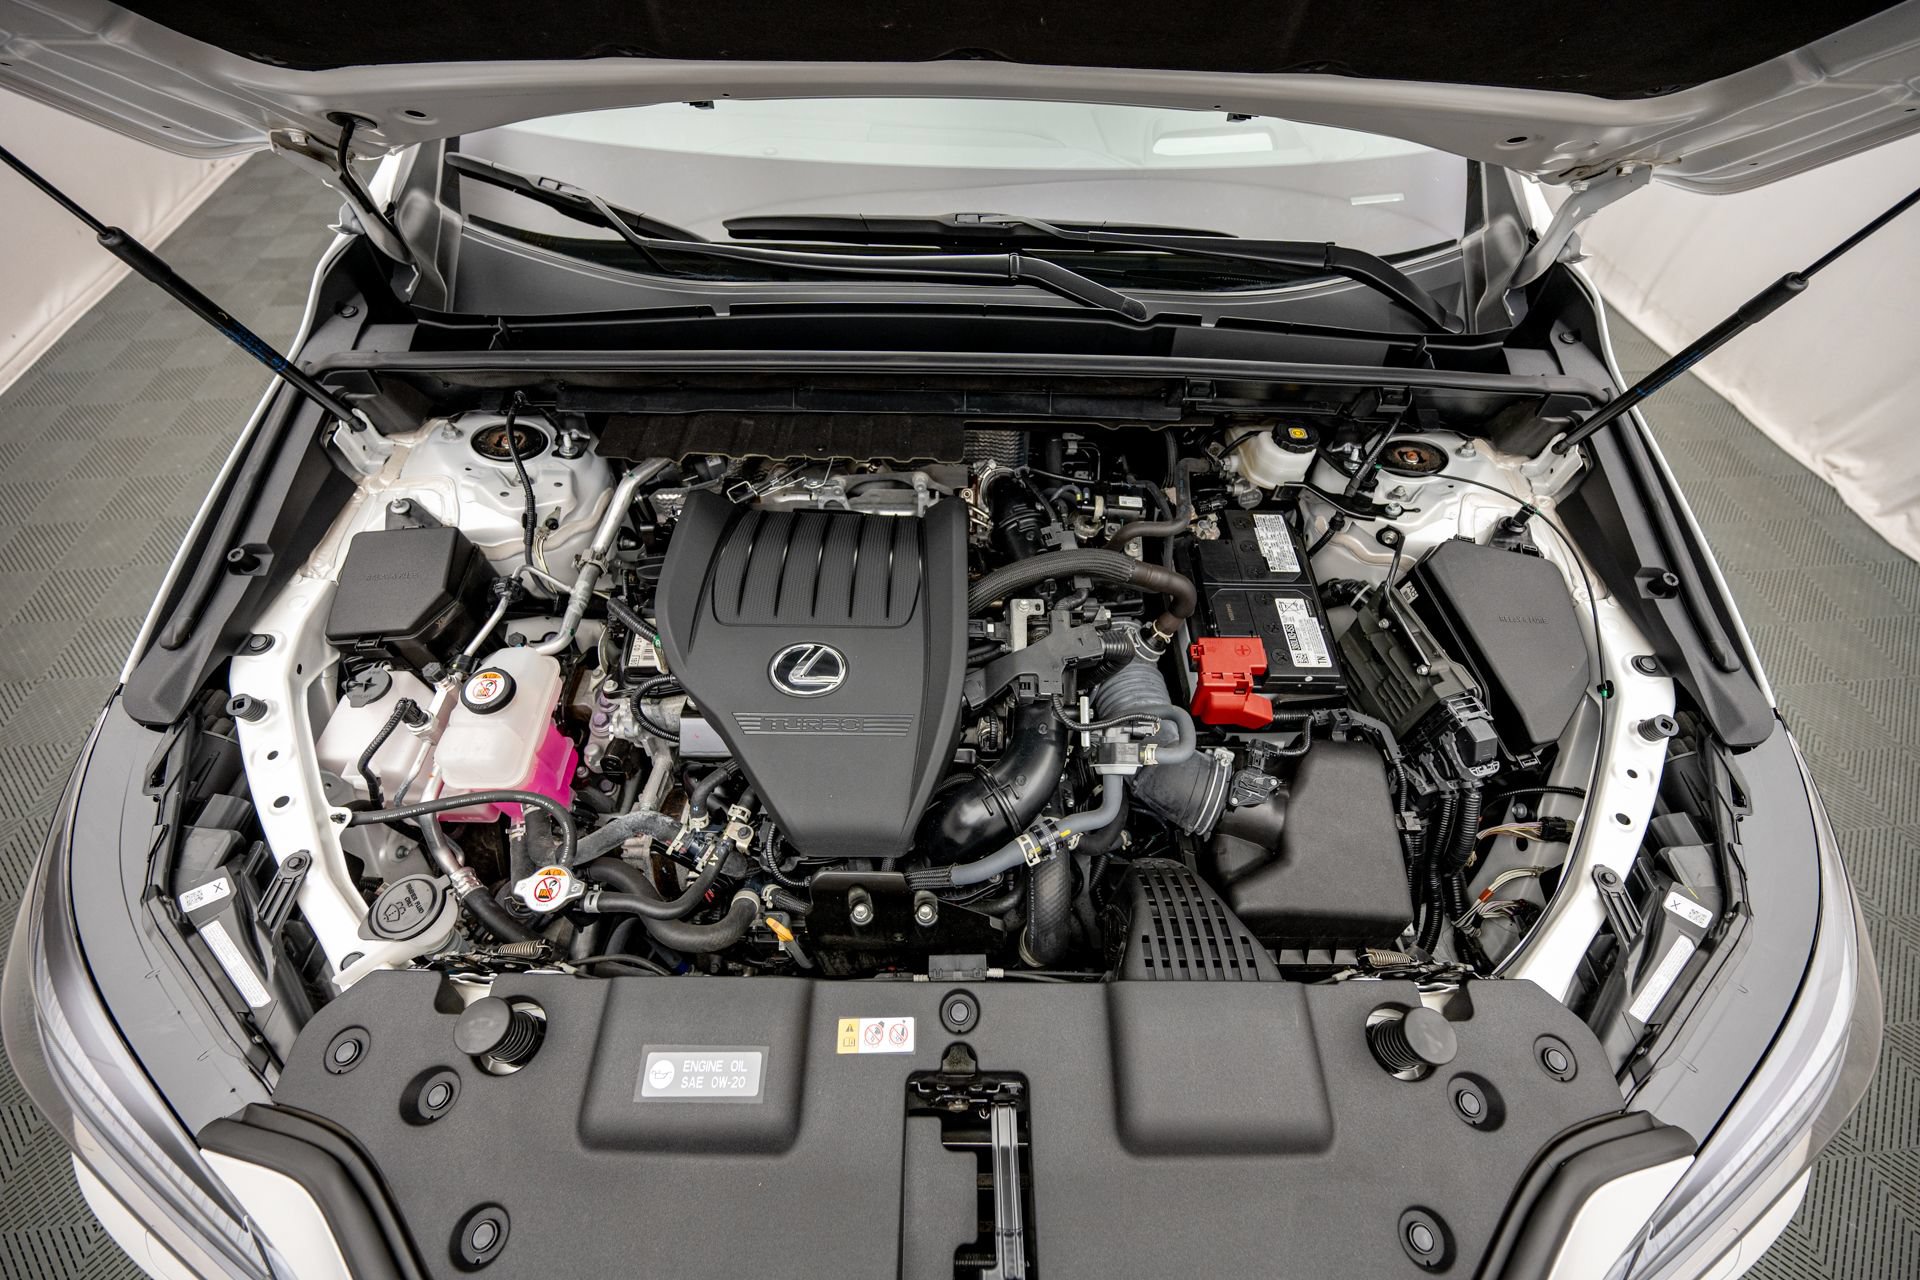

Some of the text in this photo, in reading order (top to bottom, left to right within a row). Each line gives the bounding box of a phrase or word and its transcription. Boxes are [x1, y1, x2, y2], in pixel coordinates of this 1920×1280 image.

[765, 717, 860, 731] TURBO
[414, 901, 425, 914] FLUID
[682, 1060, 748, 1072] ENGINE OIL
[680, 1076, 746, 1088] SAE 0W-20
